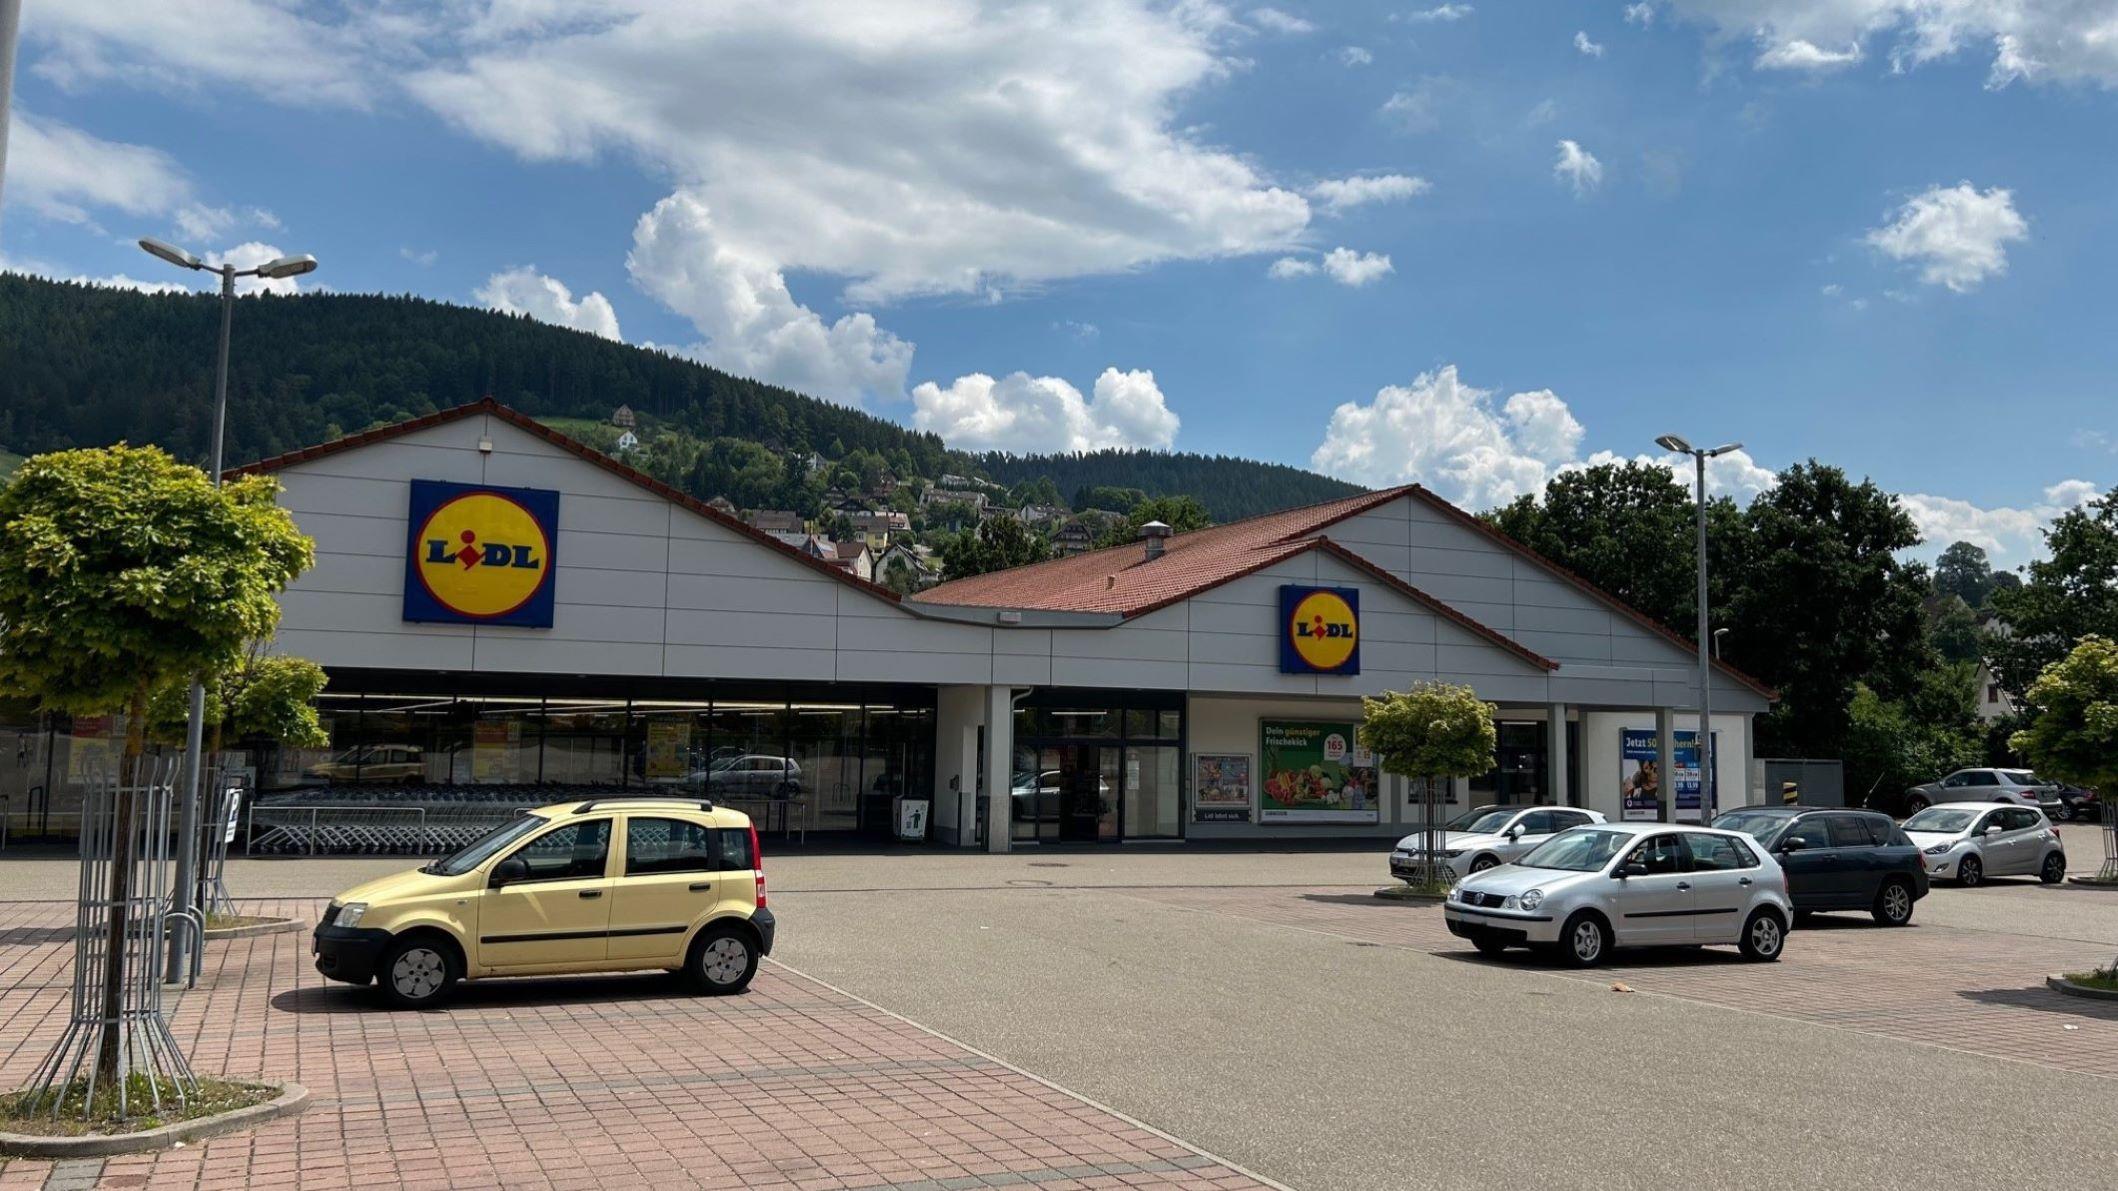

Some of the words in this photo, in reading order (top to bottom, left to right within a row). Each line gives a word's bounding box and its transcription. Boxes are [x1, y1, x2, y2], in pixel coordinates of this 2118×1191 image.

[1266, 727, 1283, 735] Dein
[1285, 728, 1320, 737] günstiger
[1266, 737, 1307, 745] Frischekick
[1626, 737, 1646, 747] Jetzt
